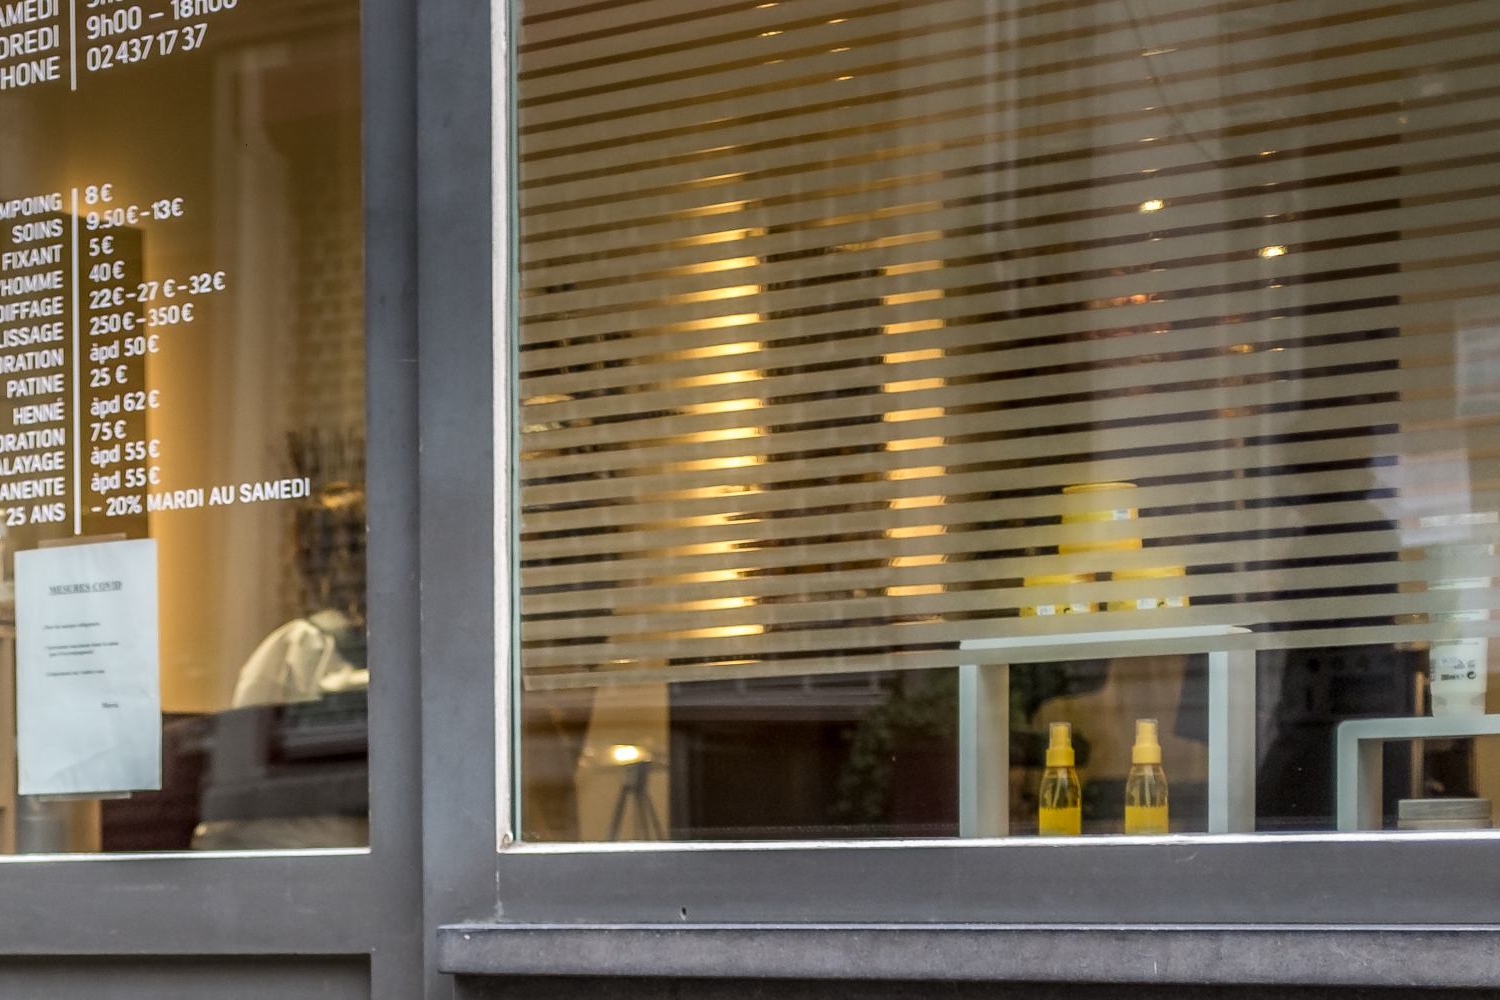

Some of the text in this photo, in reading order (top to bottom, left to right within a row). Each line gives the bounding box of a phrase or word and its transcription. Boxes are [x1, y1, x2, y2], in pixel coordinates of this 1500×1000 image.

[86, 6, 142, 39] 9h00
[11, 218, 63, 244] SOINS
[2, 244, 63, 271] FIXANT
[89, 260, 125, 282] 40€
[6, 373, 65, 399] PATINE
[13, 397, 65, 426] HENNÉ
[147, 489, 204, 512] MARDI
[209, 485, 234, 506] AU
[239, 477, 310, 503] SAMEDI
[6, 502, 66, 526] 25 ANS
[49, 580, 122, 595] MESURES COVID
